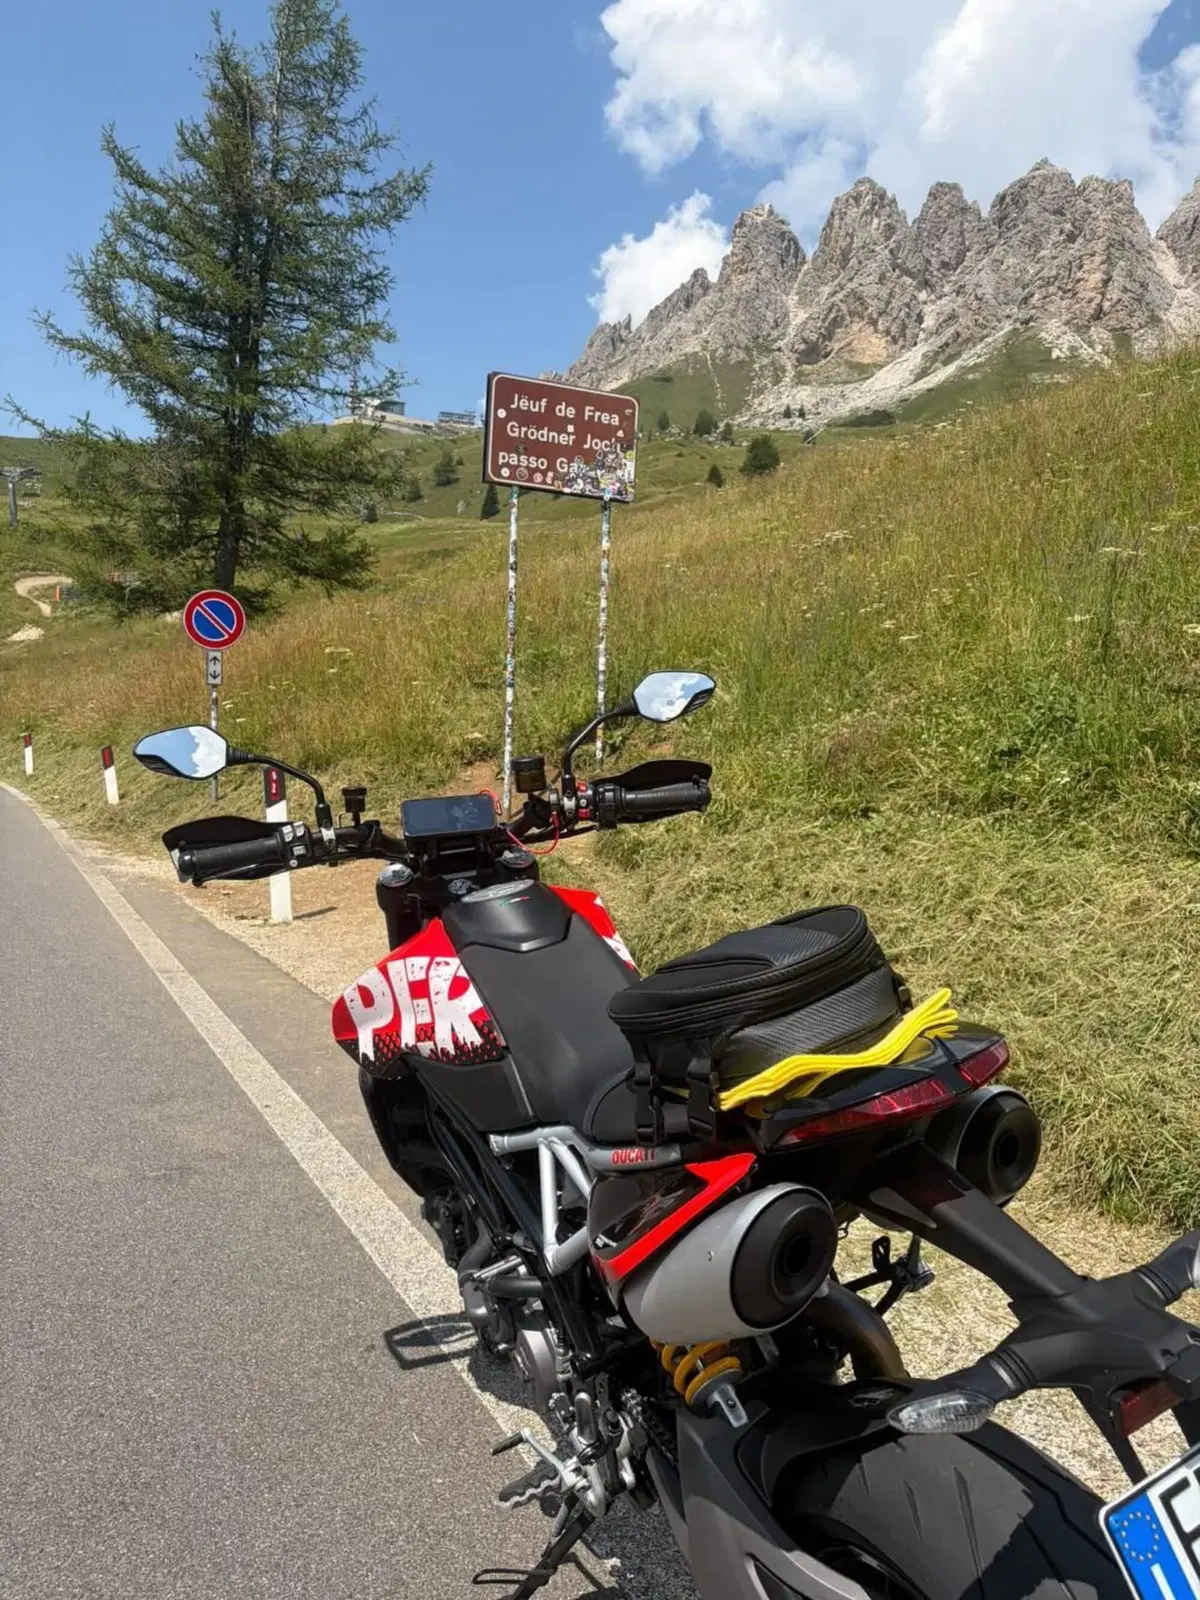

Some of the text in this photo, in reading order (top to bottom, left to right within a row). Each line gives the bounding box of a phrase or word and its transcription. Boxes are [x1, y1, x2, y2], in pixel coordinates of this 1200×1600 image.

[510, 393, 620, 426] Jëuf de Frea
[506, 421, 576, 446] Grödner
[498, 451, 548, 470] passo
[611, 1146, 656, 1165] DUCATI
